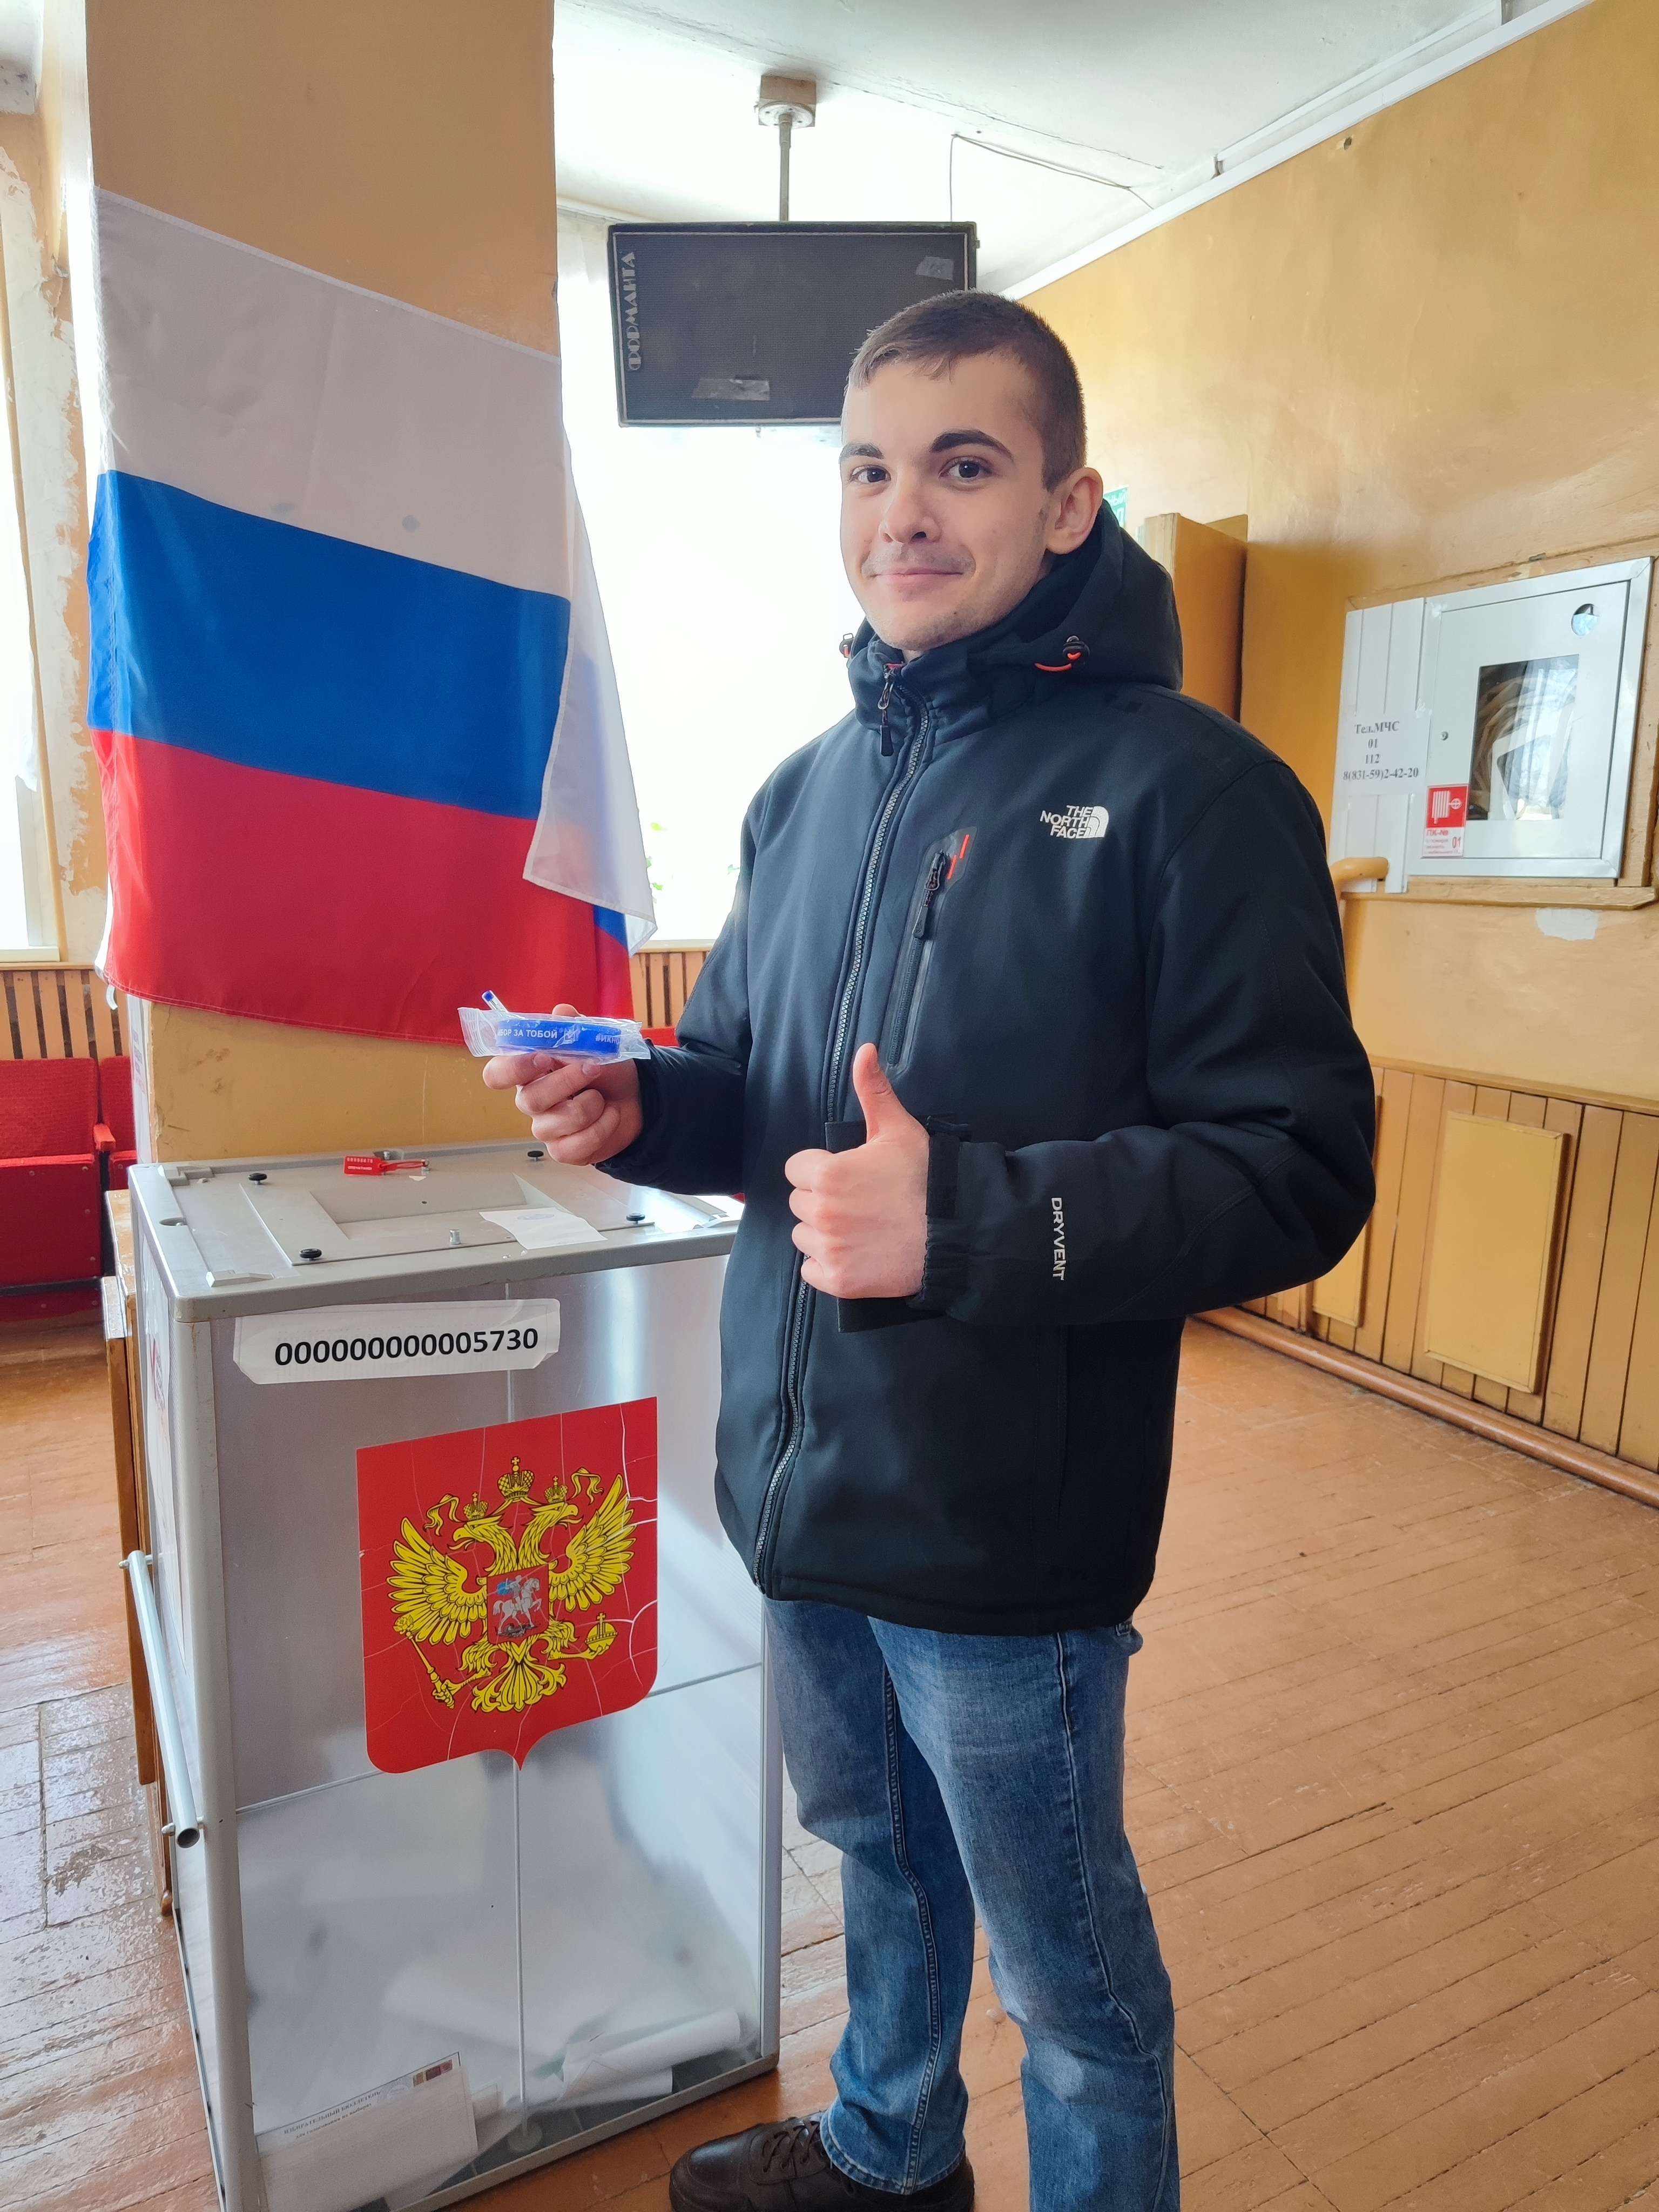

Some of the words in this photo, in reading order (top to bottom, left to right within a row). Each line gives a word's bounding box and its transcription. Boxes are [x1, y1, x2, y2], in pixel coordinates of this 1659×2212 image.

[1368, 738, 1378, 748] 01
[1365, 754, 1380, 764] 112
[1343, 767, 1419, 781] 8(831-59)2-42-20
[1066, 805, 1094, 817] THE
[1040, 810, 1089, 828] NORTH
[1050, 825, 1087, 839] FACE
[513, 1029, 524, 1037] ЗА
[525, 1029, 558, 1038] ТОБОЙ
[1051, 1197, 1067, 1281] DRYVENT
[274, 1327, 539, 1366] 000000000005730
